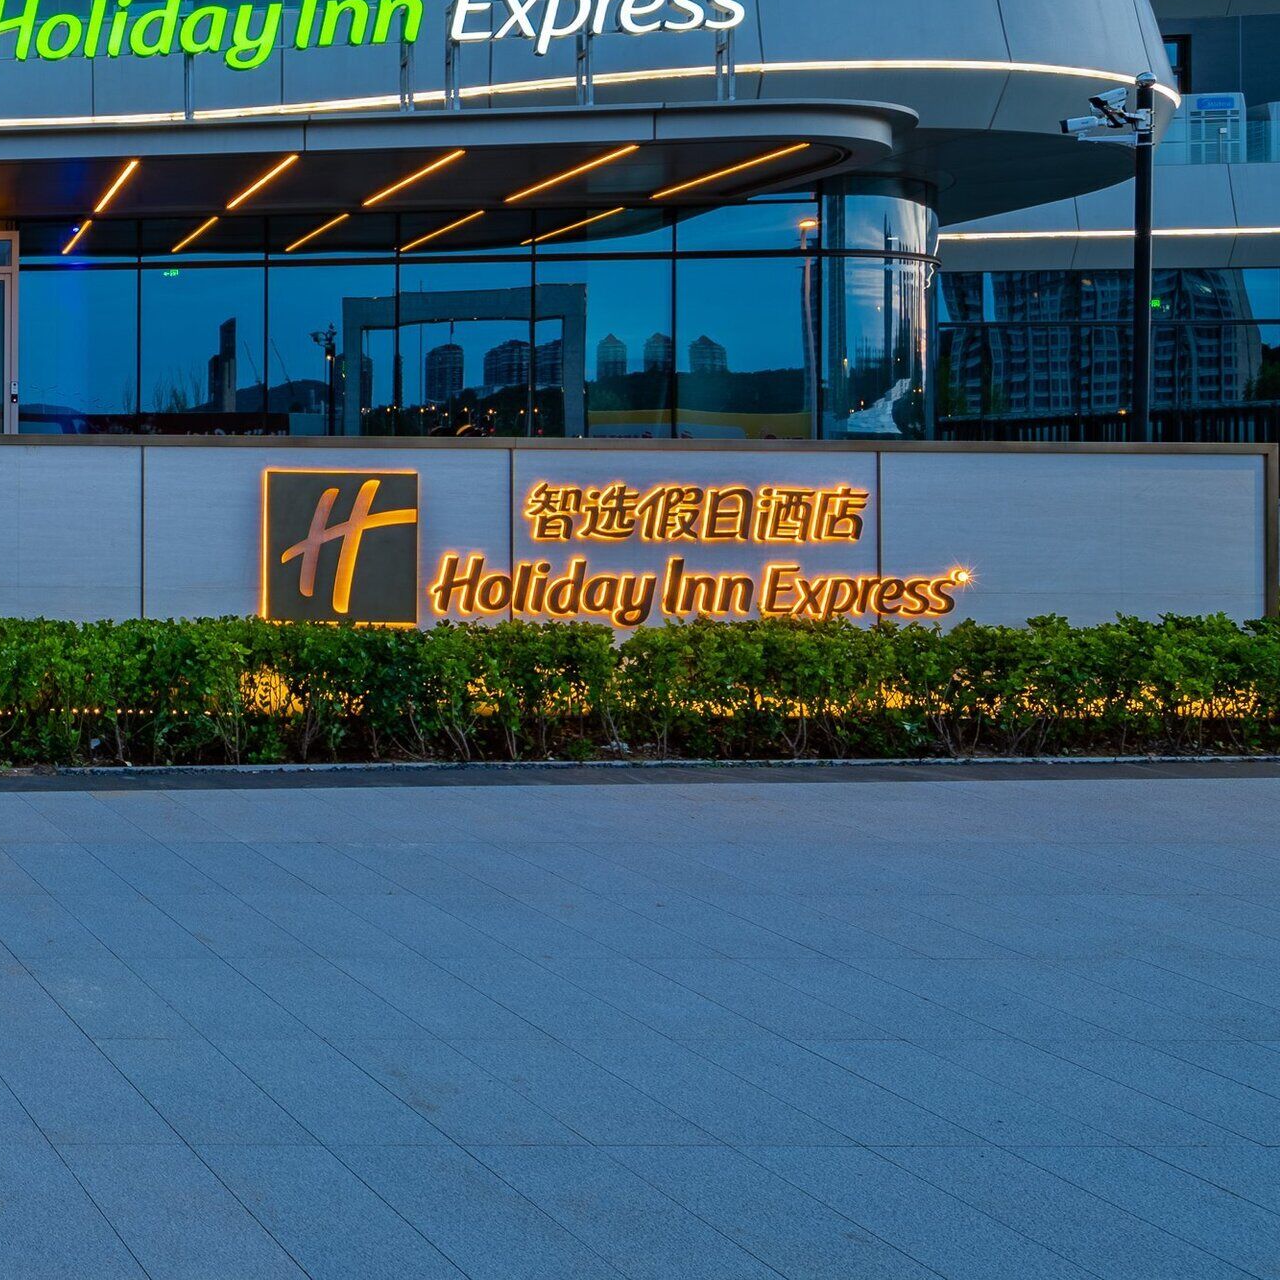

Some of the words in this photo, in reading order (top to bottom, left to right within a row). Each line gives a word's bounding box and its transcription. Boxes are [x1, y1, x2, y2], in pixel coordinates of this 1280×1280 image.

[528, 481, 870, 542] 智选假日酒店
[431, 553, 656, 626] Holiday
[664, 556, 756, 615] Inn
[766, 564, 957, 620] Express
